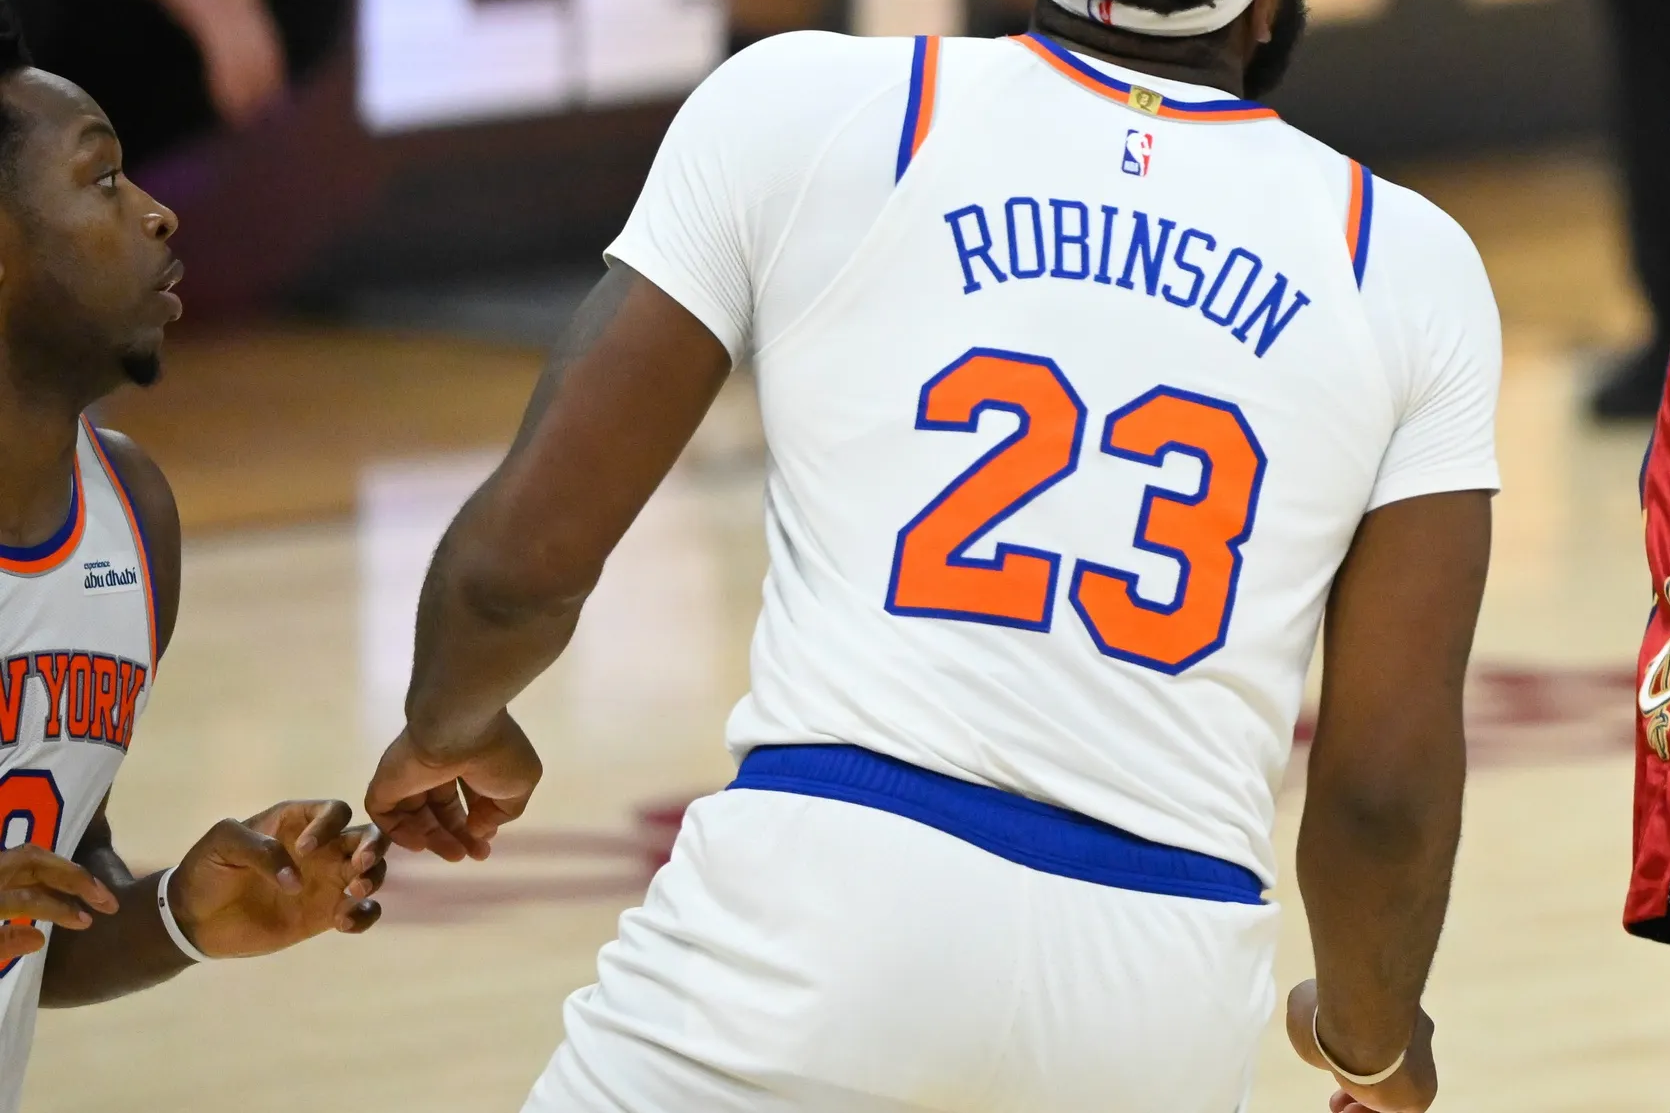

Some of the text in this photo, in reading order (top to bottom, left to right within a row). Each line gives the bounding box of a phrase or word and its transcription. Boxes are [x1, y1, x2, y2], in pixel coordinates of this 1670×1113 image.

[943, 196, 1312, 359] ROBINSON
[884, 346, 1269, 677] 23
[84, 559, 111, 571] experience
[84, 567, 138, 589] abu dhabi
[34, 649, 148, 755] YORK
